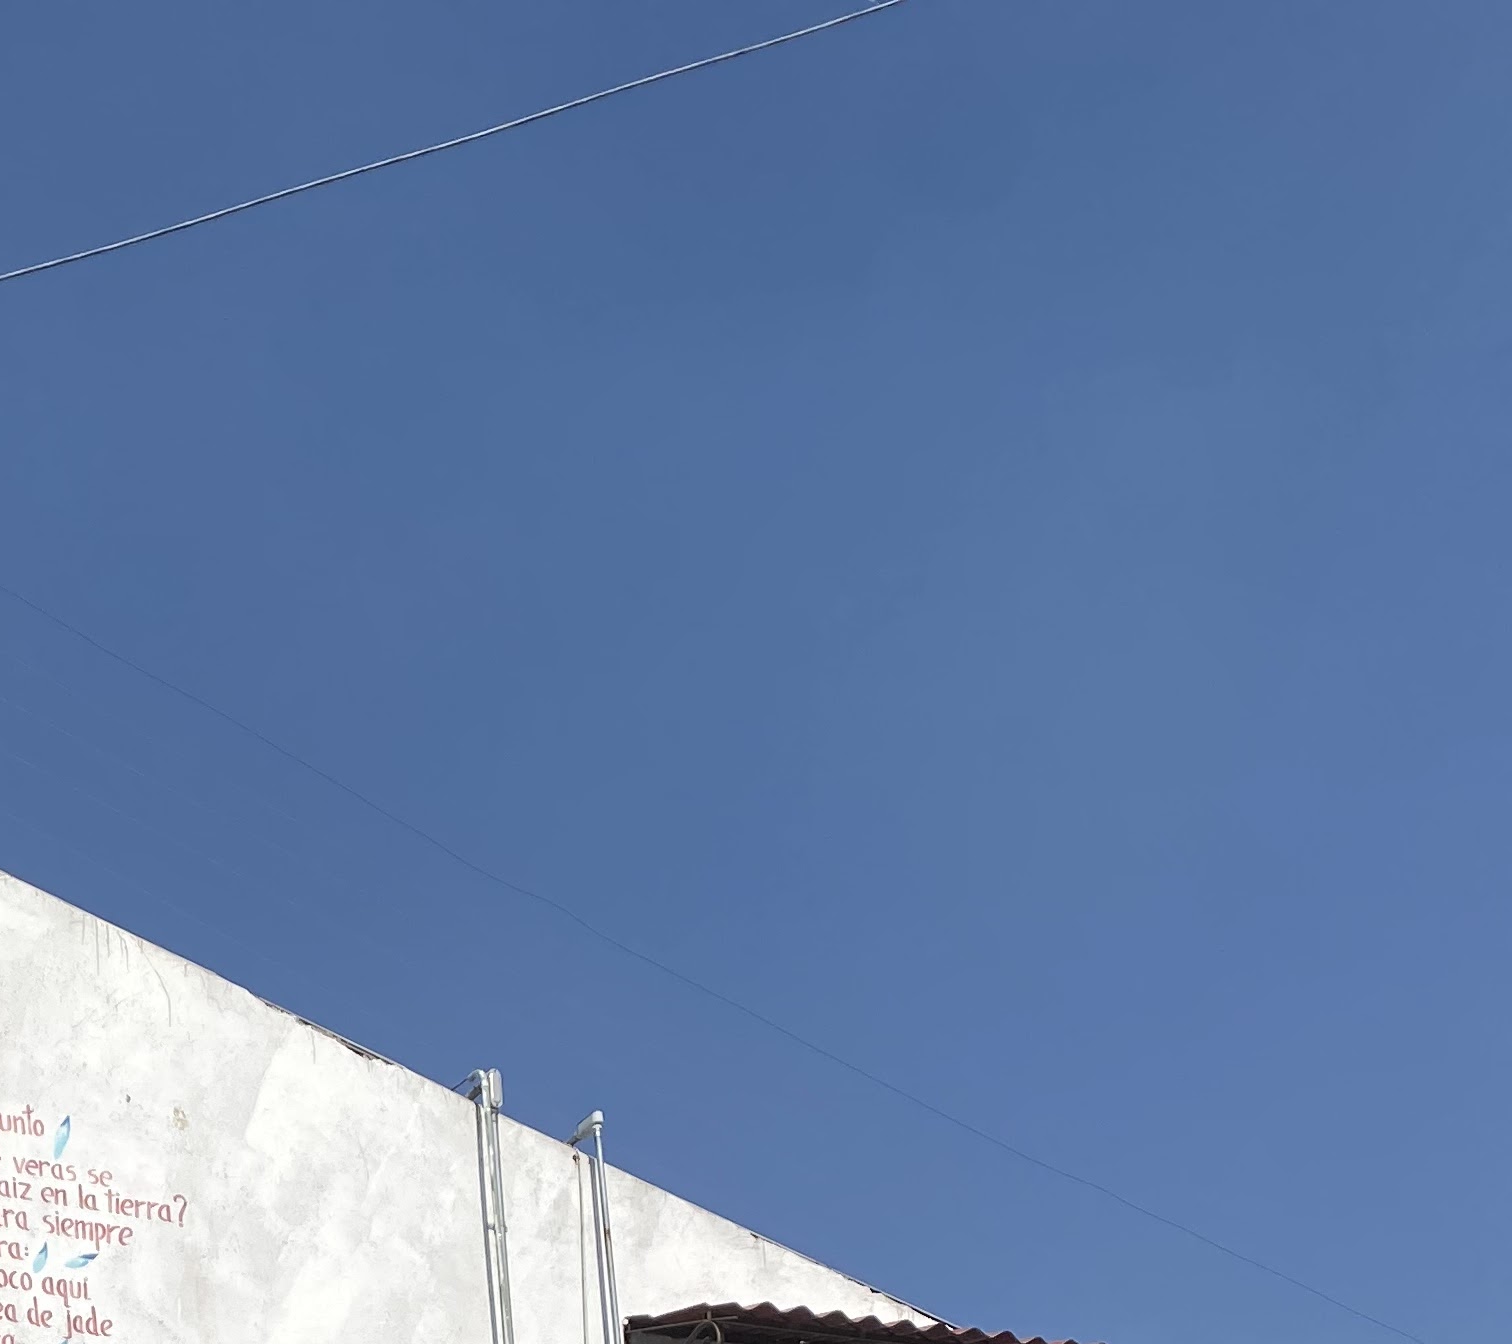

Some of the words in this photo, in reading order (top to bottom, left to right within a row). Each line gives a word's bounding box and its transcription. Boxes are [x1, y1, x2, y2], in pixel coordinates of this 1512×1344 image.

[13, 1156, 77, 1182] veras
[88, 1168, 113, 1187] se
[41, 1186, 68, 1207] en
[78, 1183, 100, 1212] la
[104, 1188, 188, 1228] tierra?
[42, 1211, 134, 1250] siempre
[27, 1296, 53, 1328] de
[65, 1306, 113, 1339] jade
